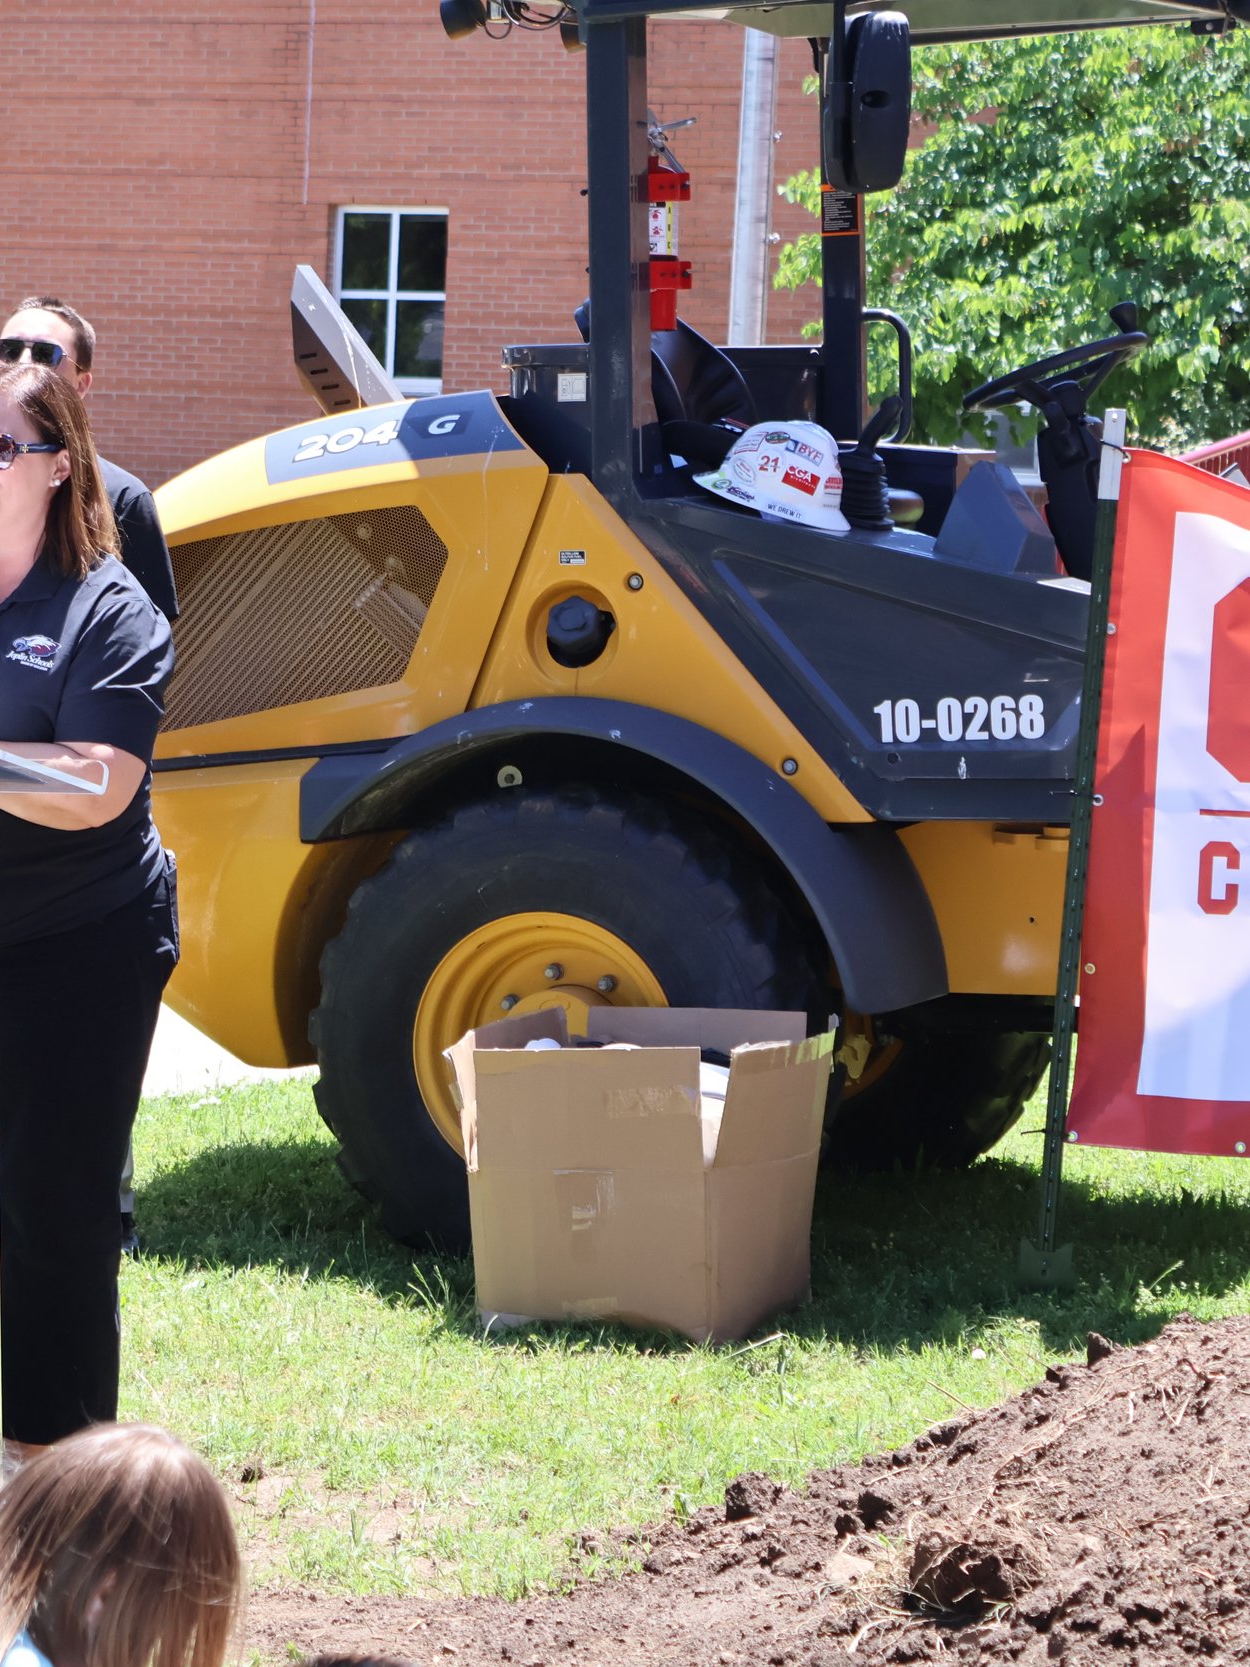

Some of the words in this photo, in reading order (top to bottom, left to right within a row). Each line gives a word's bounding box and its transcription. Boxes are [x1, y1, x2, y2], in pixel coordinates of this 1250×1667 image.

[292, 419, 400, 464] 204
[427, 413, 461, 436] G
[758, 455, 780, 473] 21
[787, 465, 813, 483] CGA
[872, 694, 1046, 744] 10-0268
